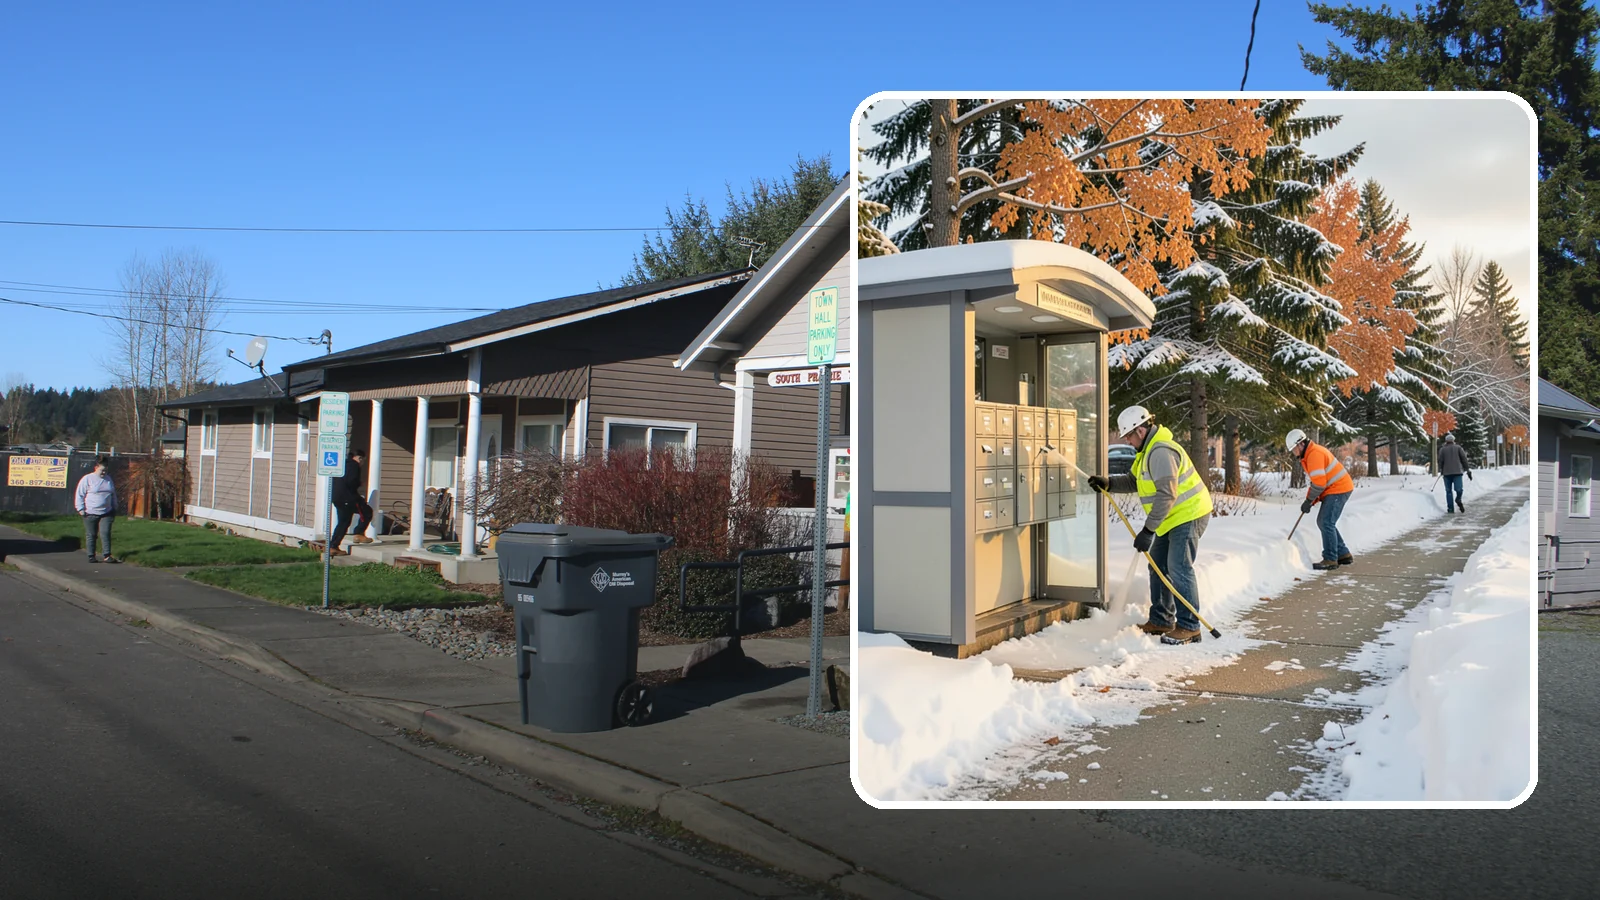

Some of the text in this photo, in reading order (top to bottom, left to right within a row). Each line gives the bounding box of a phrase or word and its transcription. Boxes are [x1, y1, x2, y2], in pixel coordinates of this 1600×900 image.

[815, 294, 833, 308] TOWN
[814, 311, 831, 325] HALL
[810, 326, 835, 341] PARKING
[813, 343, 831, 357] ONLY
[775, 373, 801, 384] SOUTH
